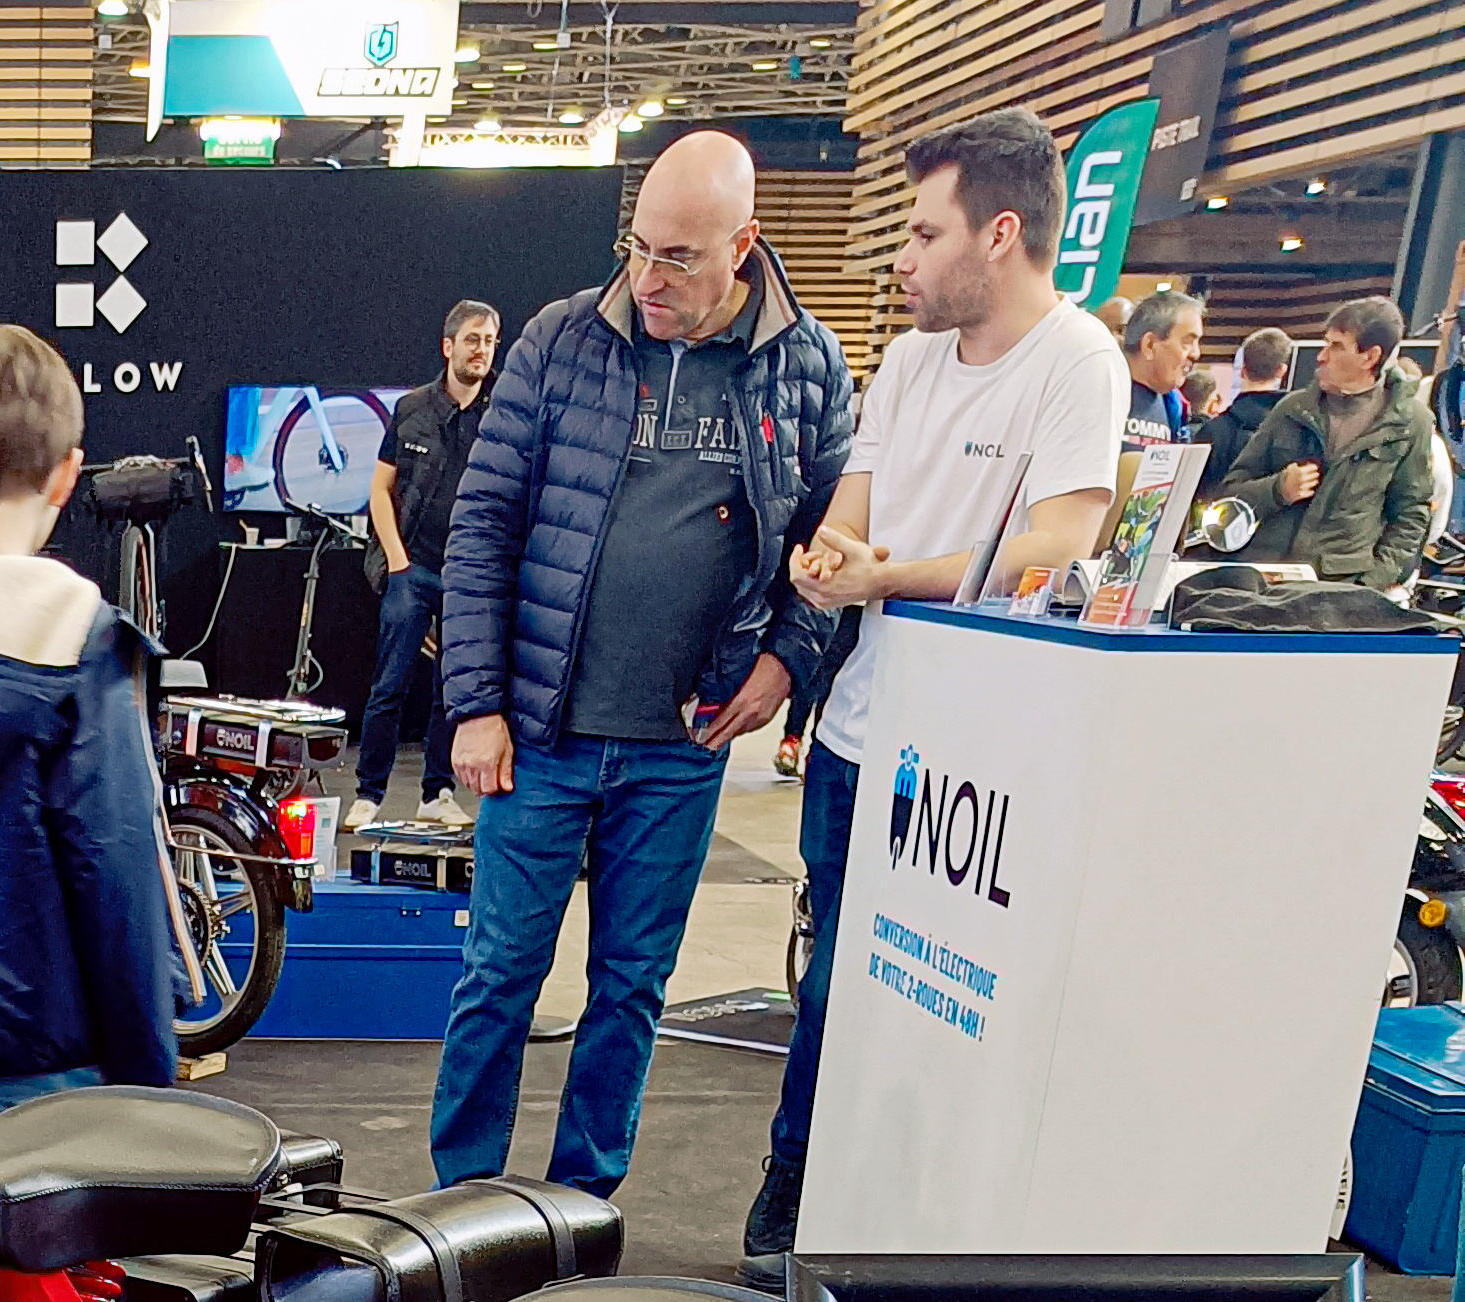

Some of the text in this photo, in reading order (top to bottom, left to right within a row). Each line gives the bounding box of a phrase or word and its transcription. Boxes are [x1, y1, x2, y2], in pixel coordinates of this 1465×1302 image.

[912, 768, 1011, 909] NOIL
[873, 912, 925, 961] CONVERSION
[869, 952, 881, 980] DE
[881, 958, 908, 996] VOTRE
[907, 974, 945, 1018] 2-ROUES
[944, 996, 960, 1026] EN
[959, 1004, 980, 1039] 48H
